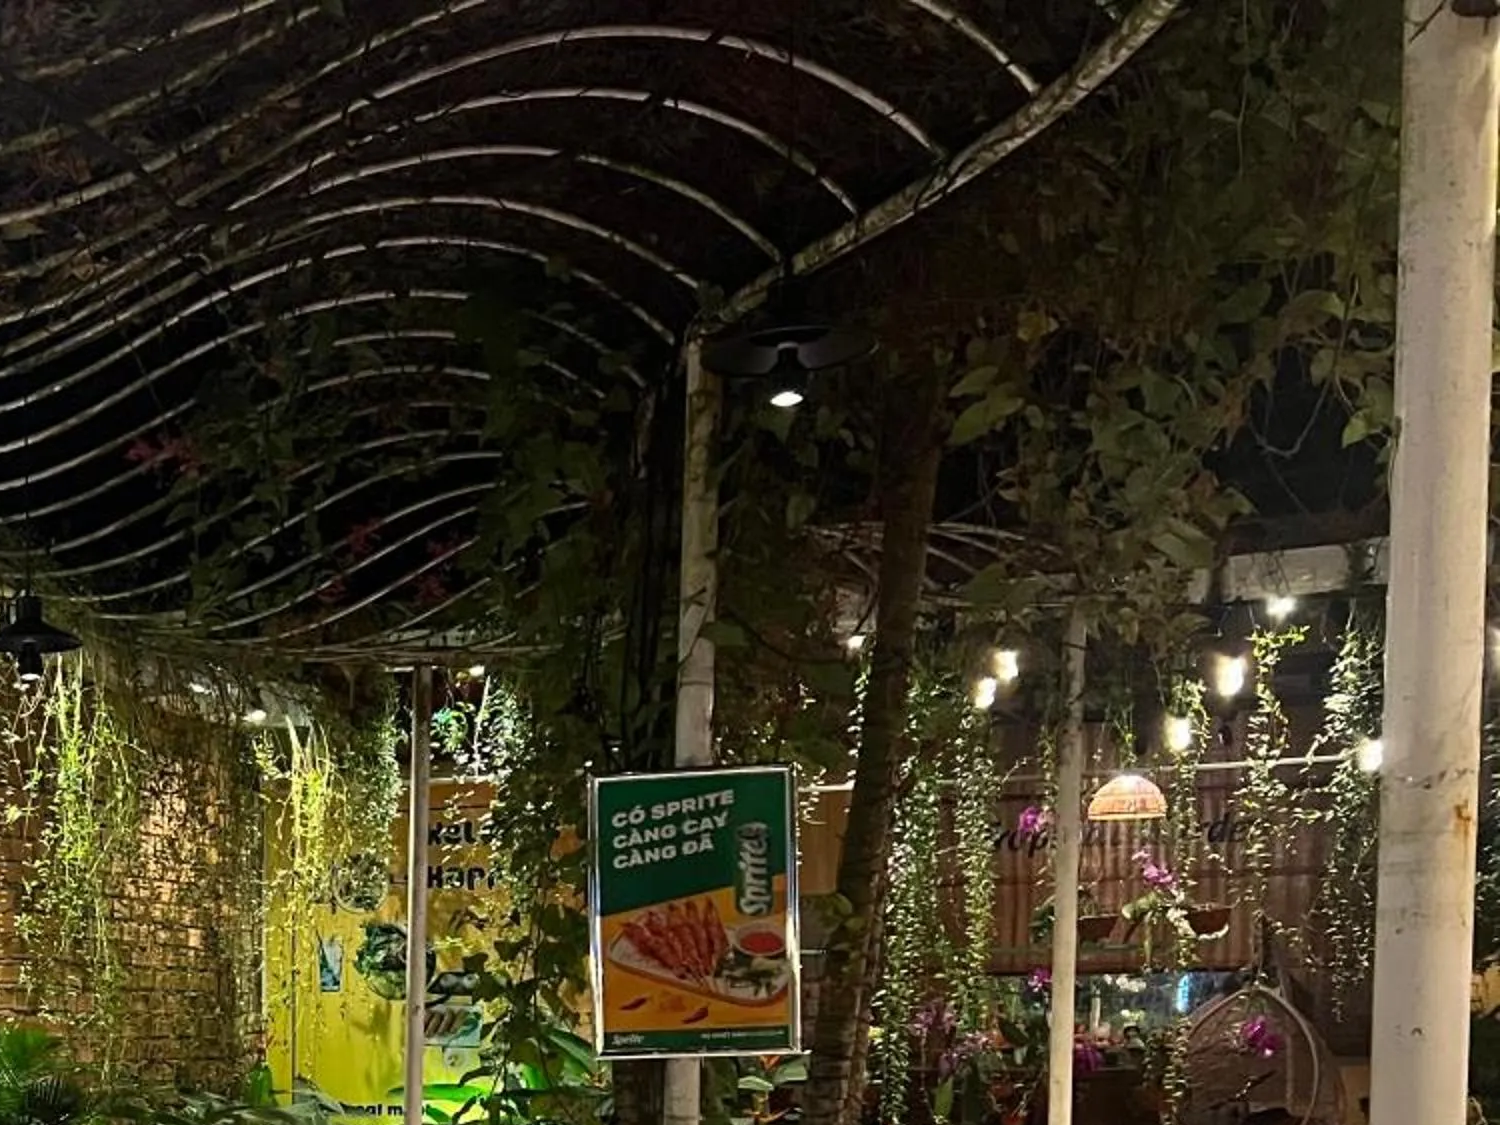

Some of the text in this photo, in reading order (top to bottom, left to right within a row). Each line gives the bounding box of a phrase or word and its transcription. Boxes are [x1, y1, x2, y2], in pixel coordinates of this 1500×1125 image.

[612, 789, 734, 828] CÓ SPRITE
[613, 808, 728, 849] CÀNG CAY
[613, 848, 677, 869] CÀNG
[738, 838, 772, 915] Sprite
